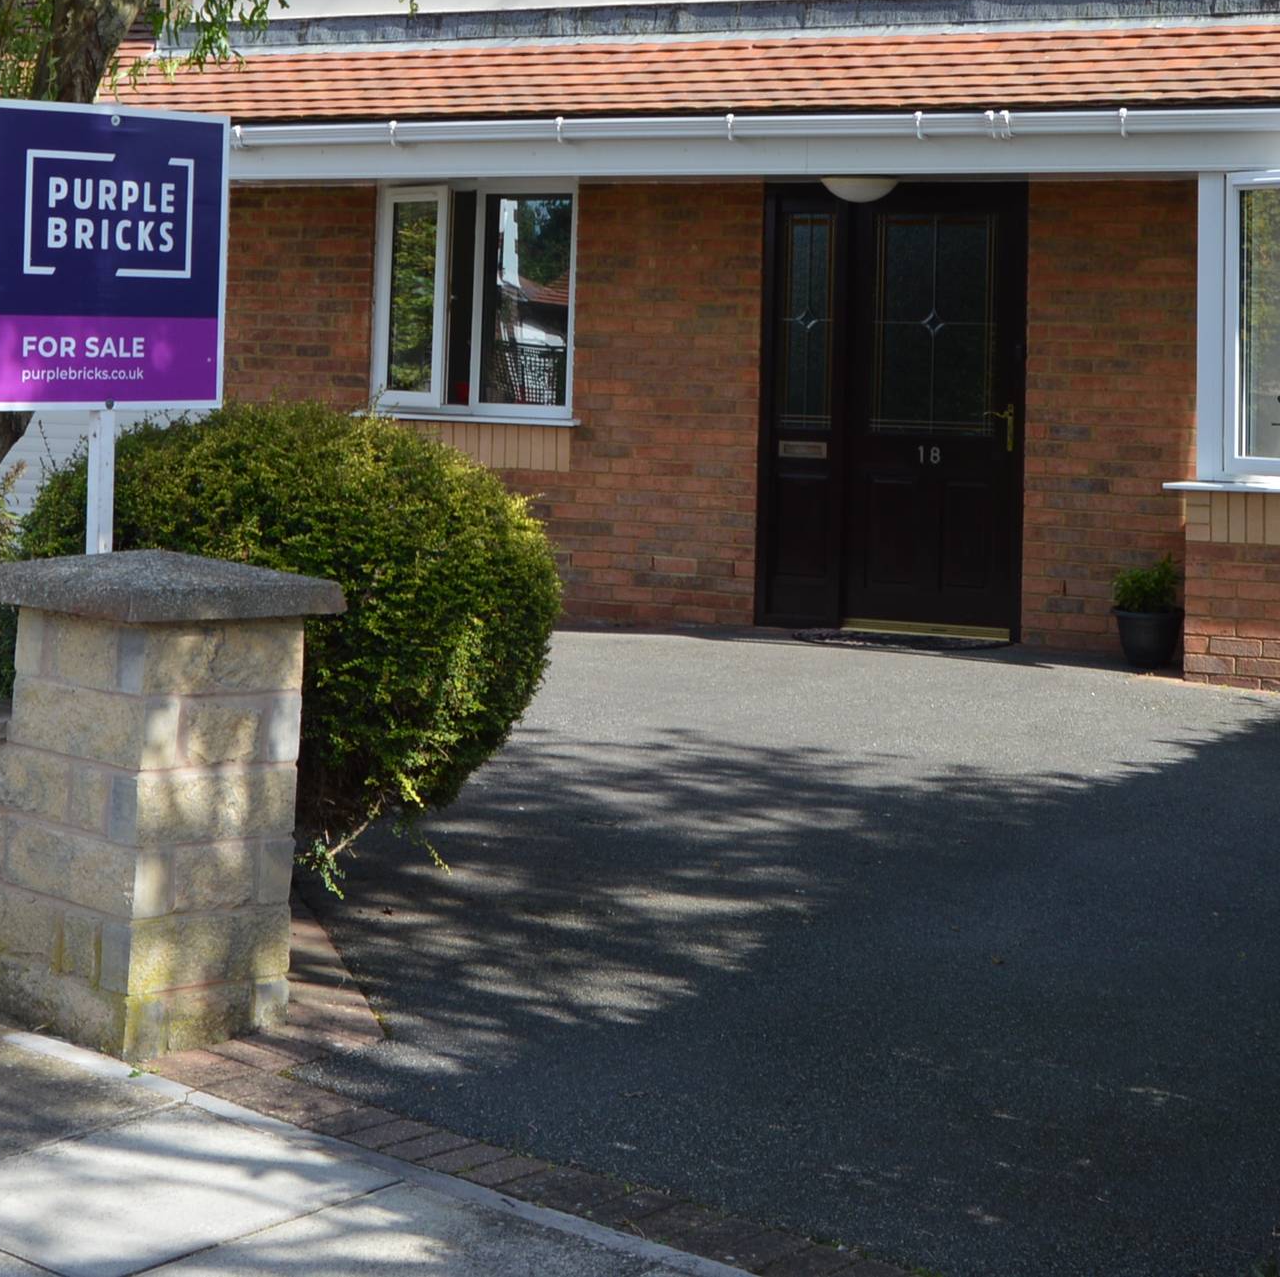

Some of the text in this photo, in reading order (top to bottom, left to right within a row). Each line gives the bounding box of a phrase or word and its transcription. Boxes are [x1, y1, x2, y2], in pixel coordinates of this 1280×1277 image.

[48, 176, 175, 214] PURPLE
[47, 216, 174, 253] BRICKS
[22, 336, 145, 359] FOR SALE
[22, 366, 144, 383] purplebricks.co.uk
[918, 445, 941, 465] 18
